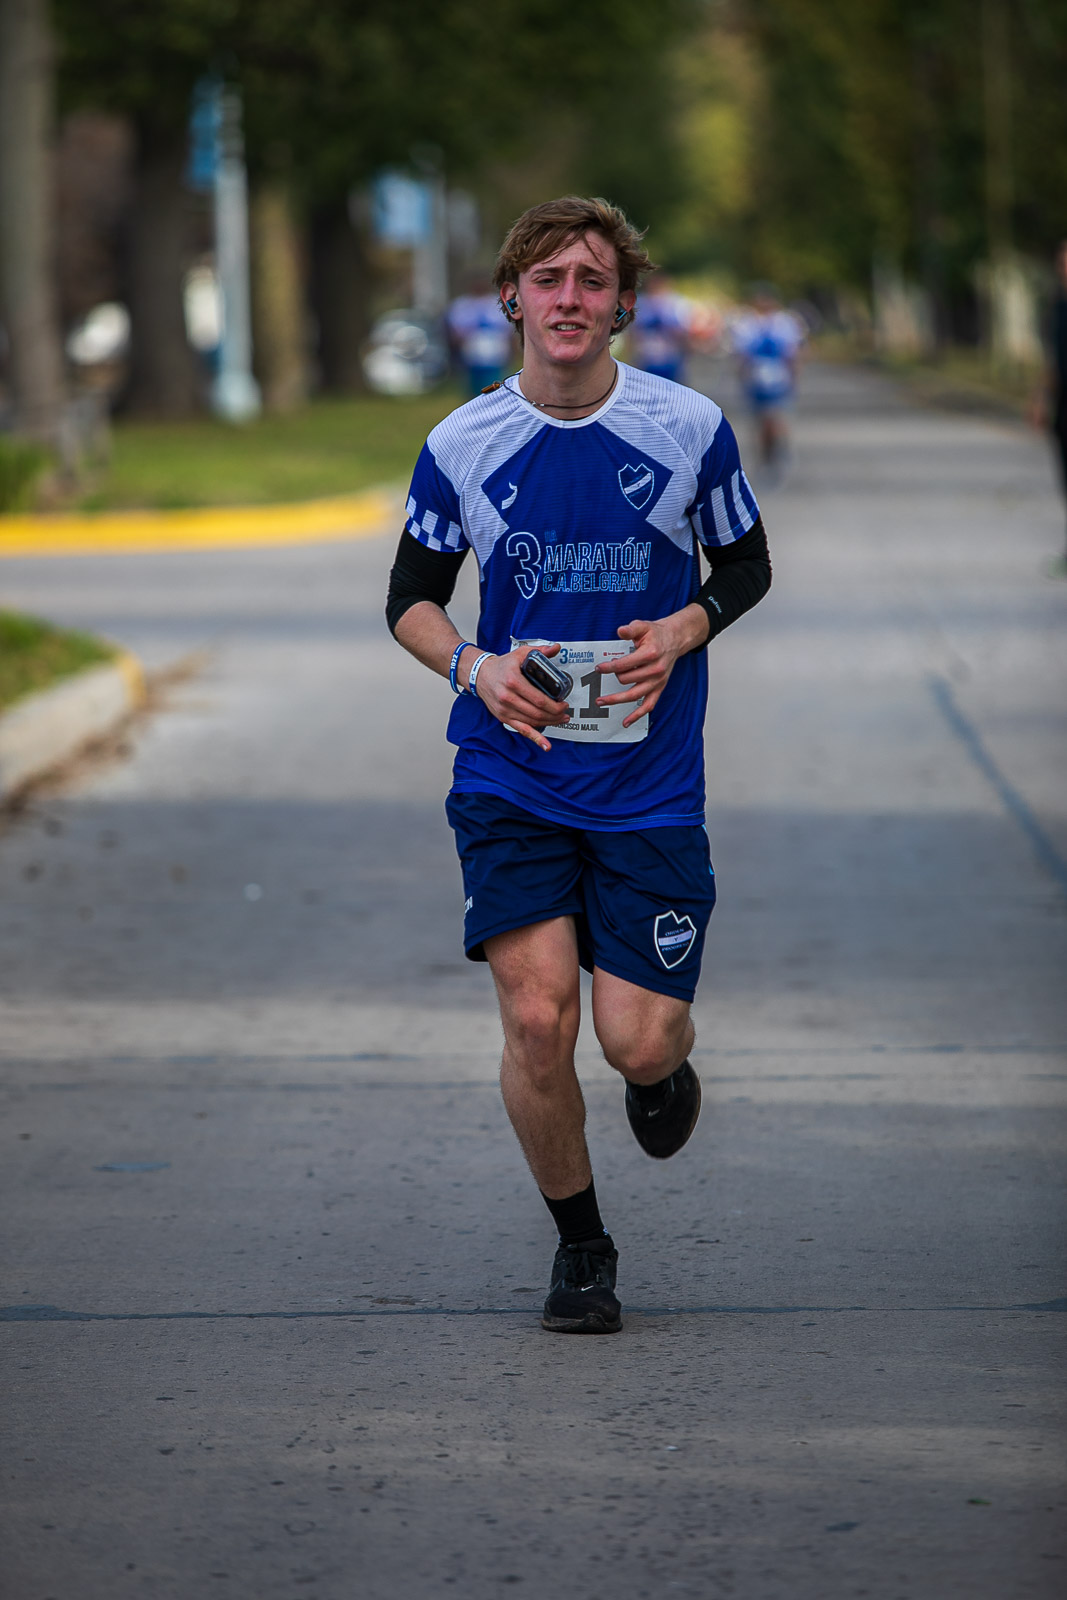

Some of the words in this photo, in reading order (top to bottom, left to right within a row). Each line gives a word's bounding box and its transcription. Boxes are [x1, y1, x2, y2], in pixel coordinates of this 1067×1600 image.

[506, 531, 541, 599] 3
[543, 537, 652, 574] MARATÓN
[560, 648, 568, 664] 3
[569, 651, 594, 659] MARATÓN
